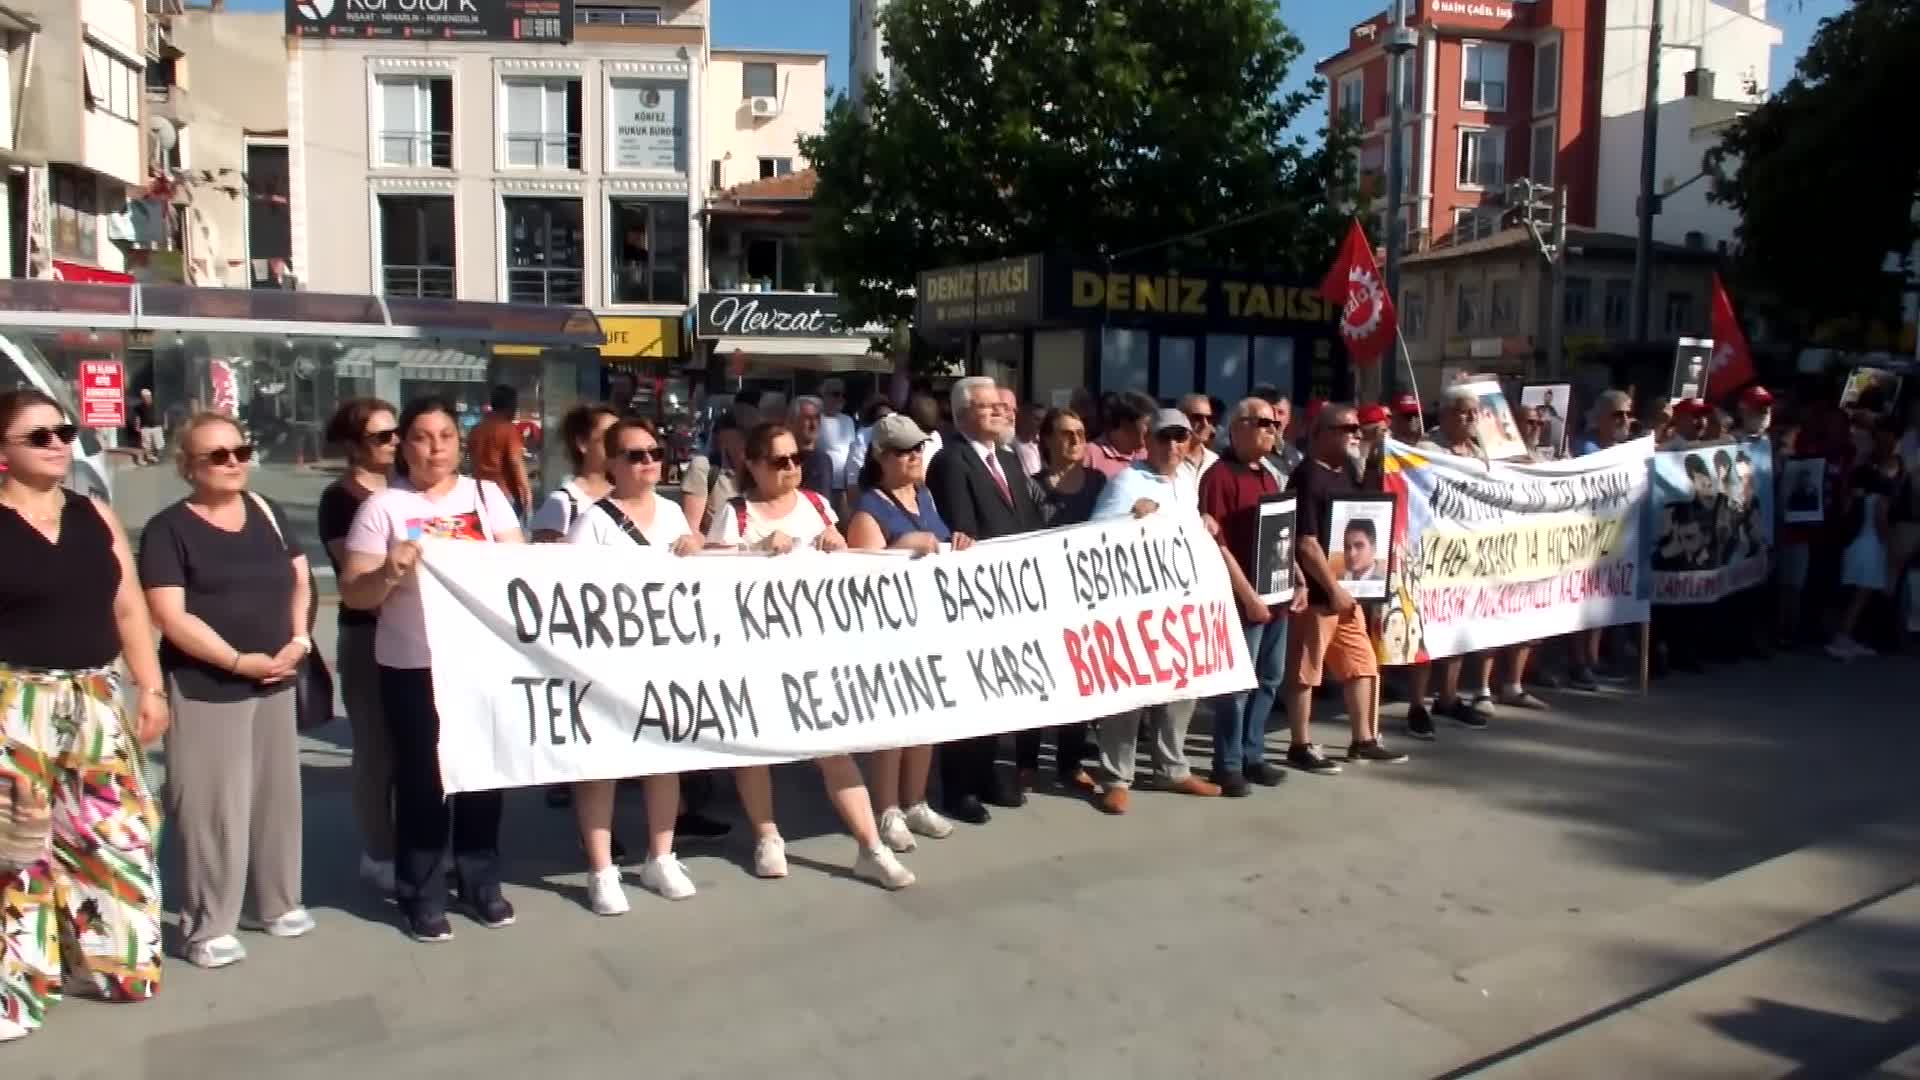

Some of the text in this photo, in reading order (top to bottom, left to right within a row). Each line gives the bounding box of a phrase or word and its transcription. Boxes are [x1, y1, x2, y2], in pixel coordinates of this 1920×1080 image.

[711, 297, 833, 334] Nevzat
[1072, 269, 1207, 313] DENİZ
[735, 570, 918, 642] KAYYUMCU
[934, 556, 1049, 623] BASKICI
[1062, 525, 1199, 610] İŞBİRLİKÇİ
[511, 600, 1235, 746] TEK ADAM REJİMİNE KARŞI BİRLEŞELİM
